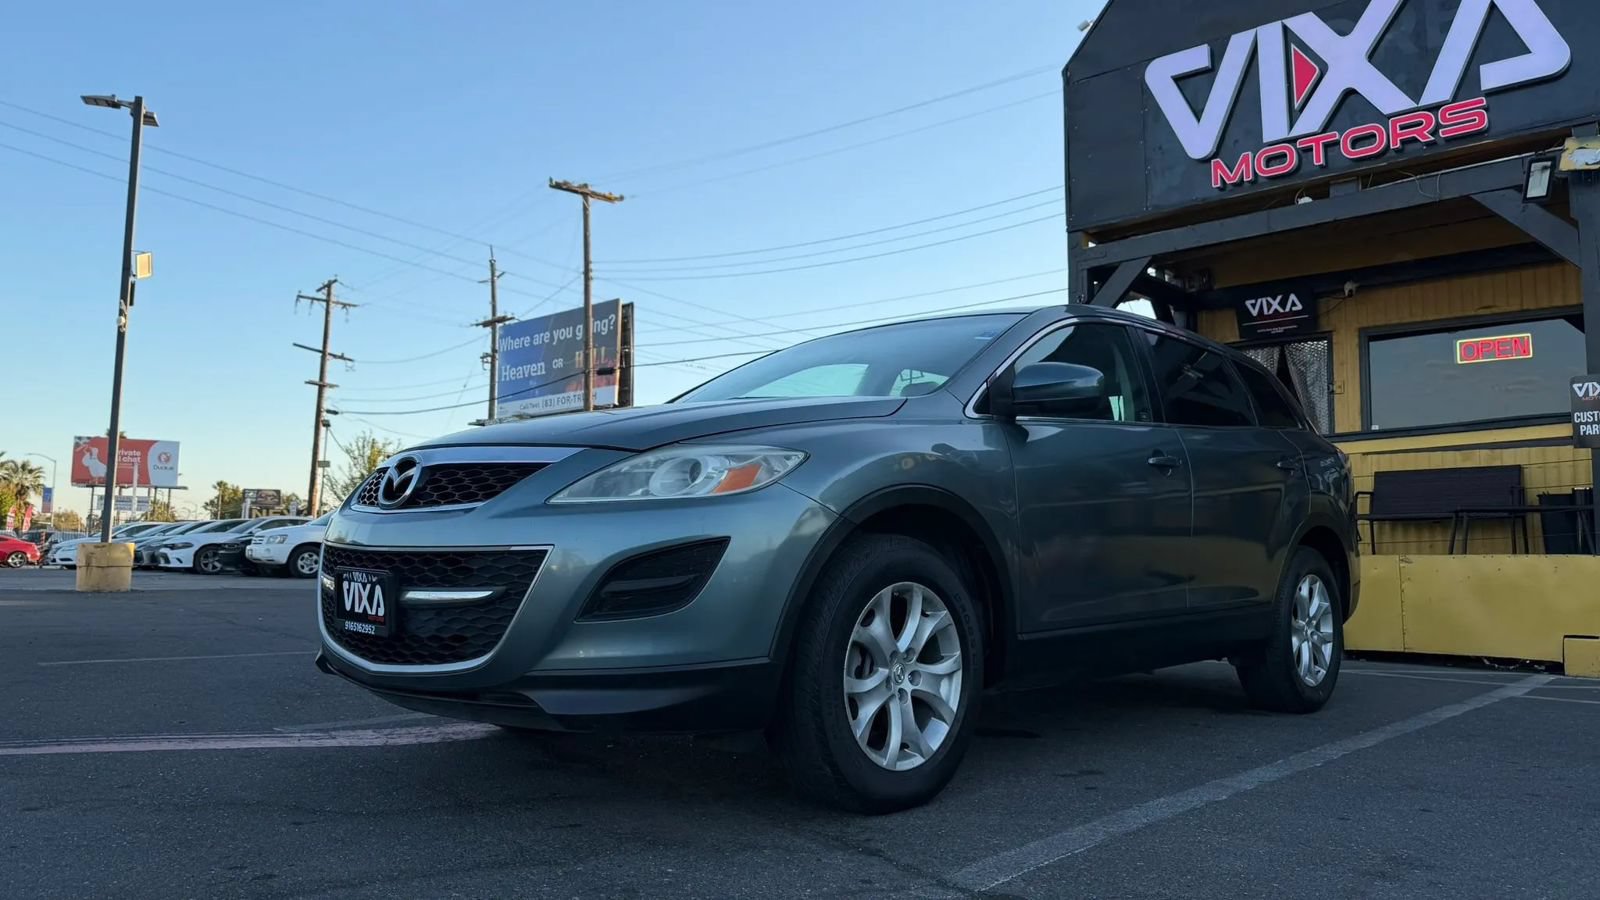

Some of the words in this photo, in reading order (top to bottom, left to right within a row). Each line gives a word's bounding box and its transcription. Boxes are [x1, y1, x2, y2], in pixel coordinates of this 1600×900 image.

[1144, 0, 1571, 160] VIXA
[1211, 97, 1488, 188] MOTORS
[1244, 293, 1303, 317] VIXA
[500, 335, 530, 352] Where
[533, 332, 550, 346] are
[553, 326, 573, 345] you
[575, 314, 616, 339] gng?
[1461, 336, 1529, 360] OPEN
[501, 361, 546, 381] Heaven
[1574, 411, 1600, 423] CUST
[1580, 424, 1600, 436] PAR
[342, 580, 385, 617] VIXA
